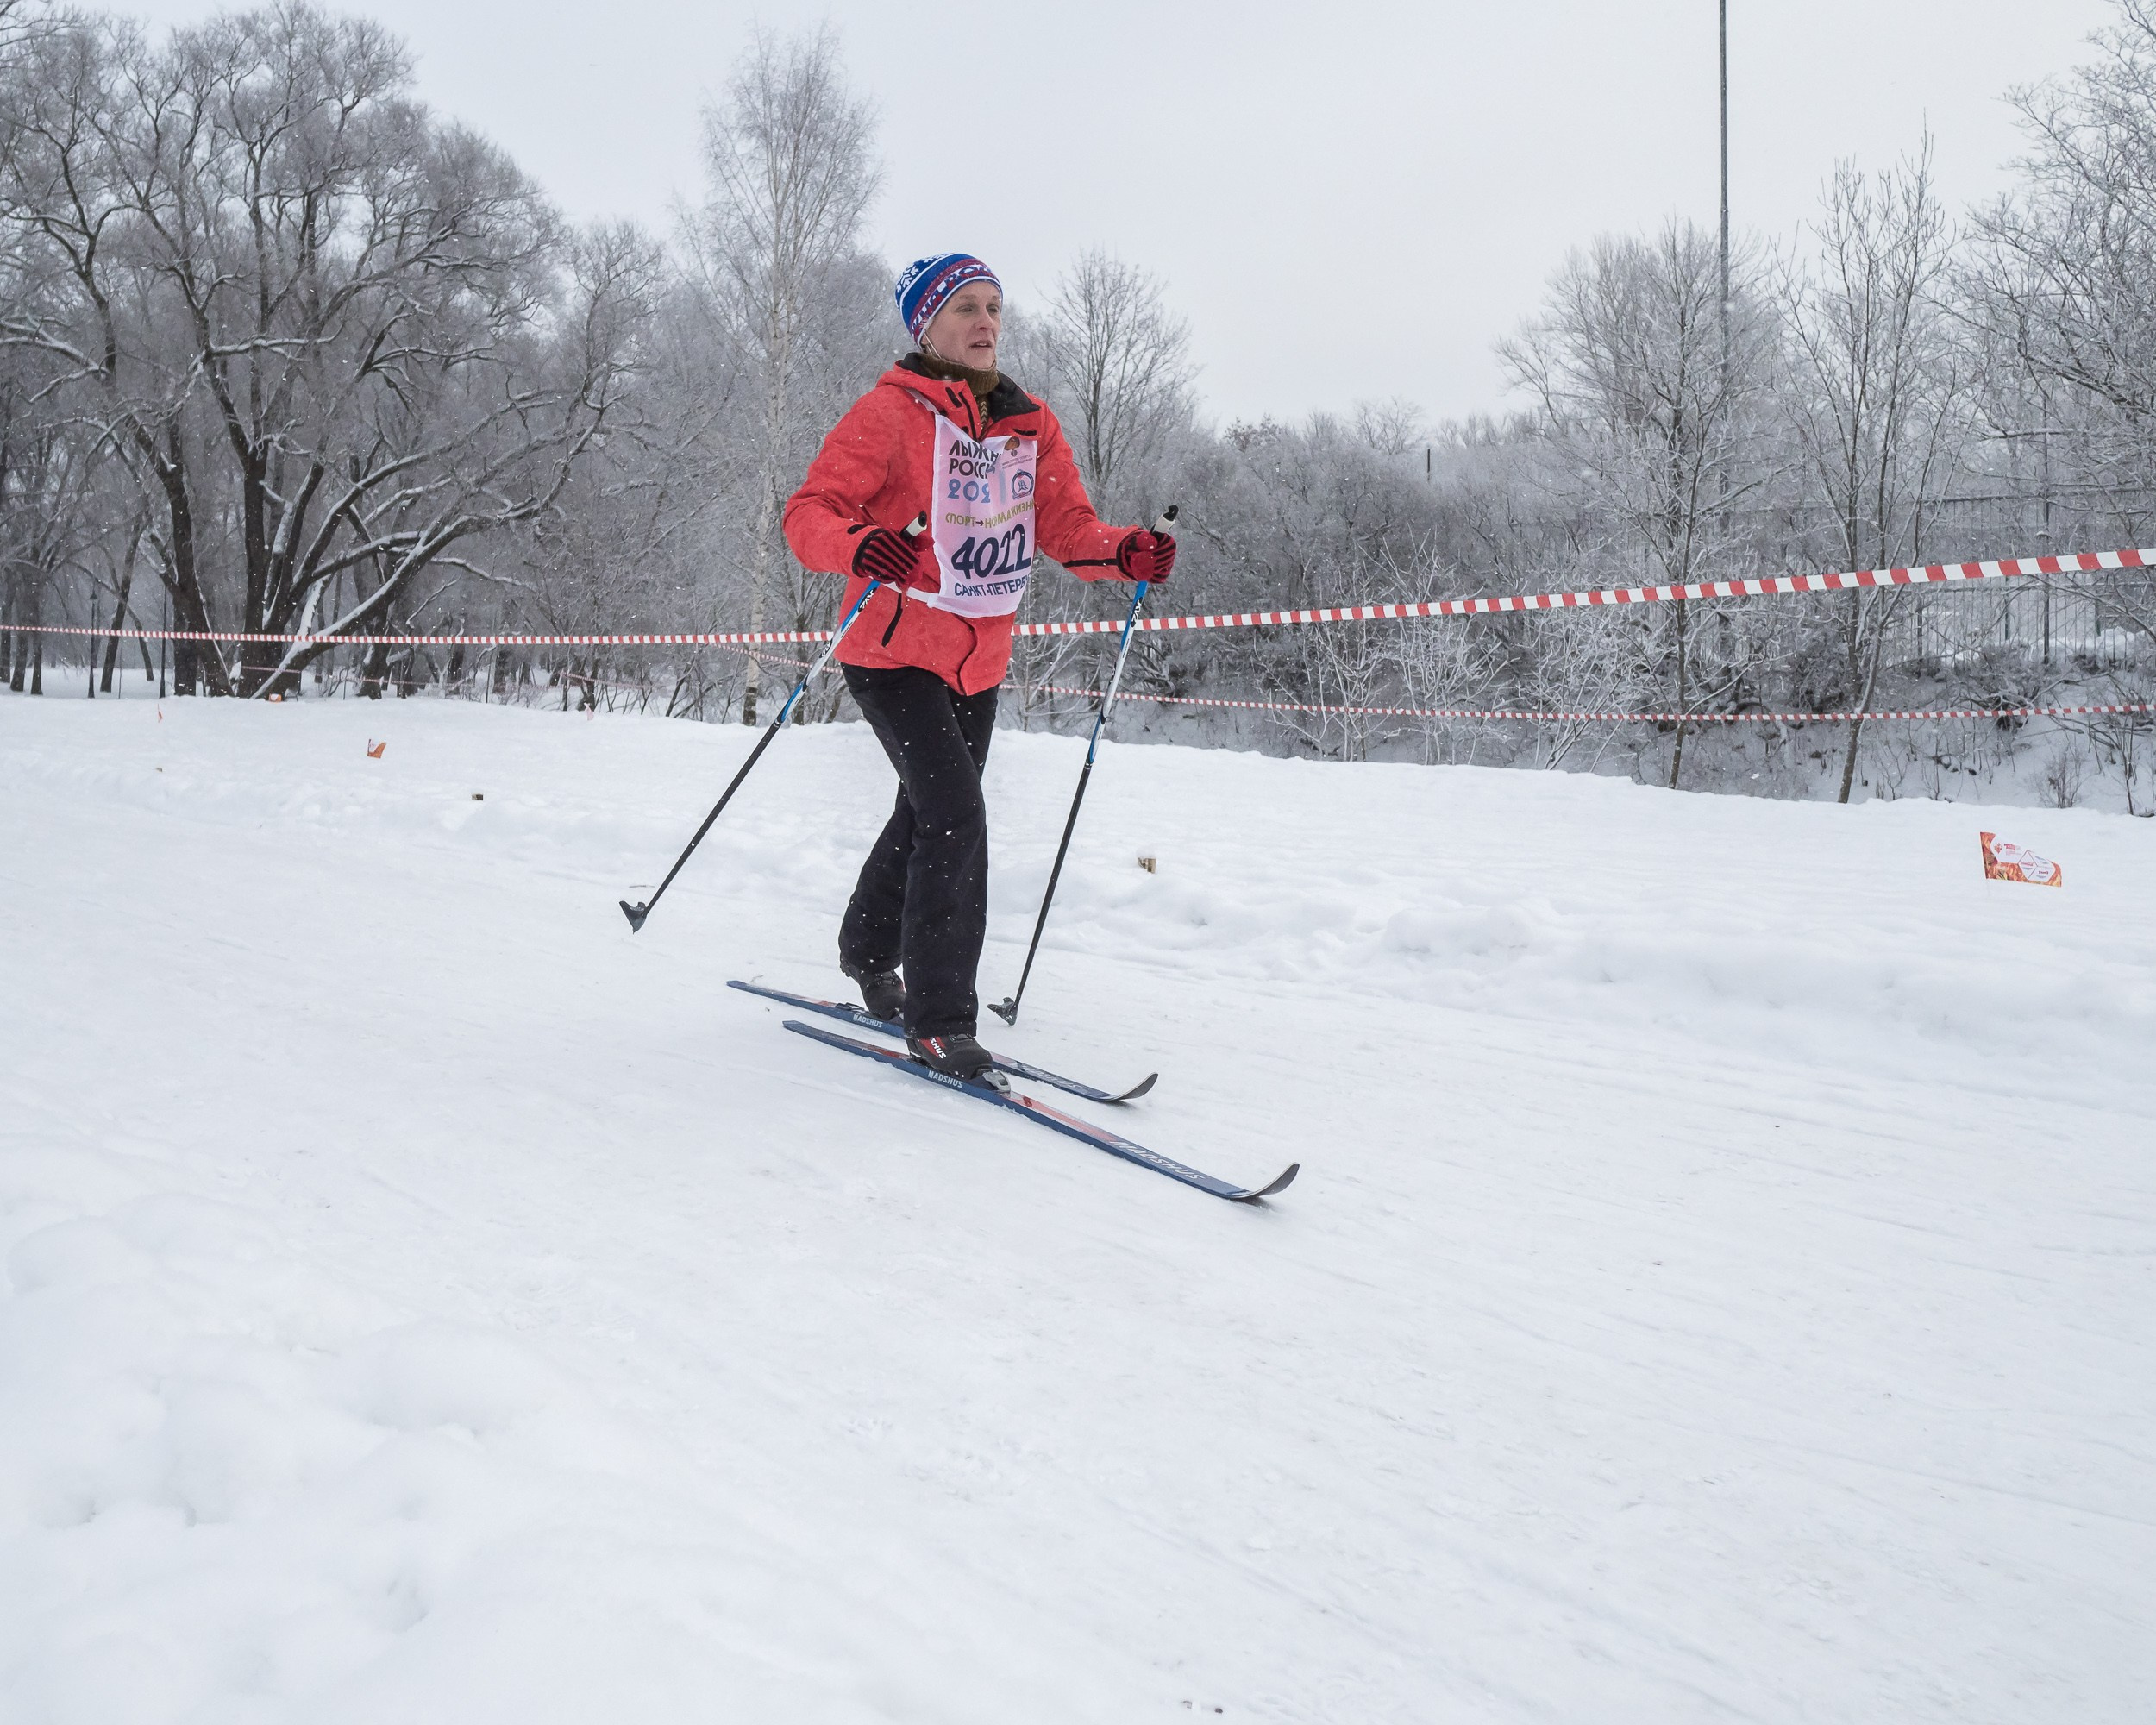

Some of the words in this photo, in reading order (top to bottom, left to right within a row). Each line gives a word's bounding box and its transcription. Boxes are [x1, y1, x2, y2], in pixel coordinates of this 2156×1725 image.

[945, 512, 976, 527] СПОРТ
[951, 524, 1031, 580] 4022
[853, 1013, 883, 1028] MADSHUS
[927, 1070, 963, 1088] MADSHUS
[1109, 1141, 1206, 1179] MADSHUS
